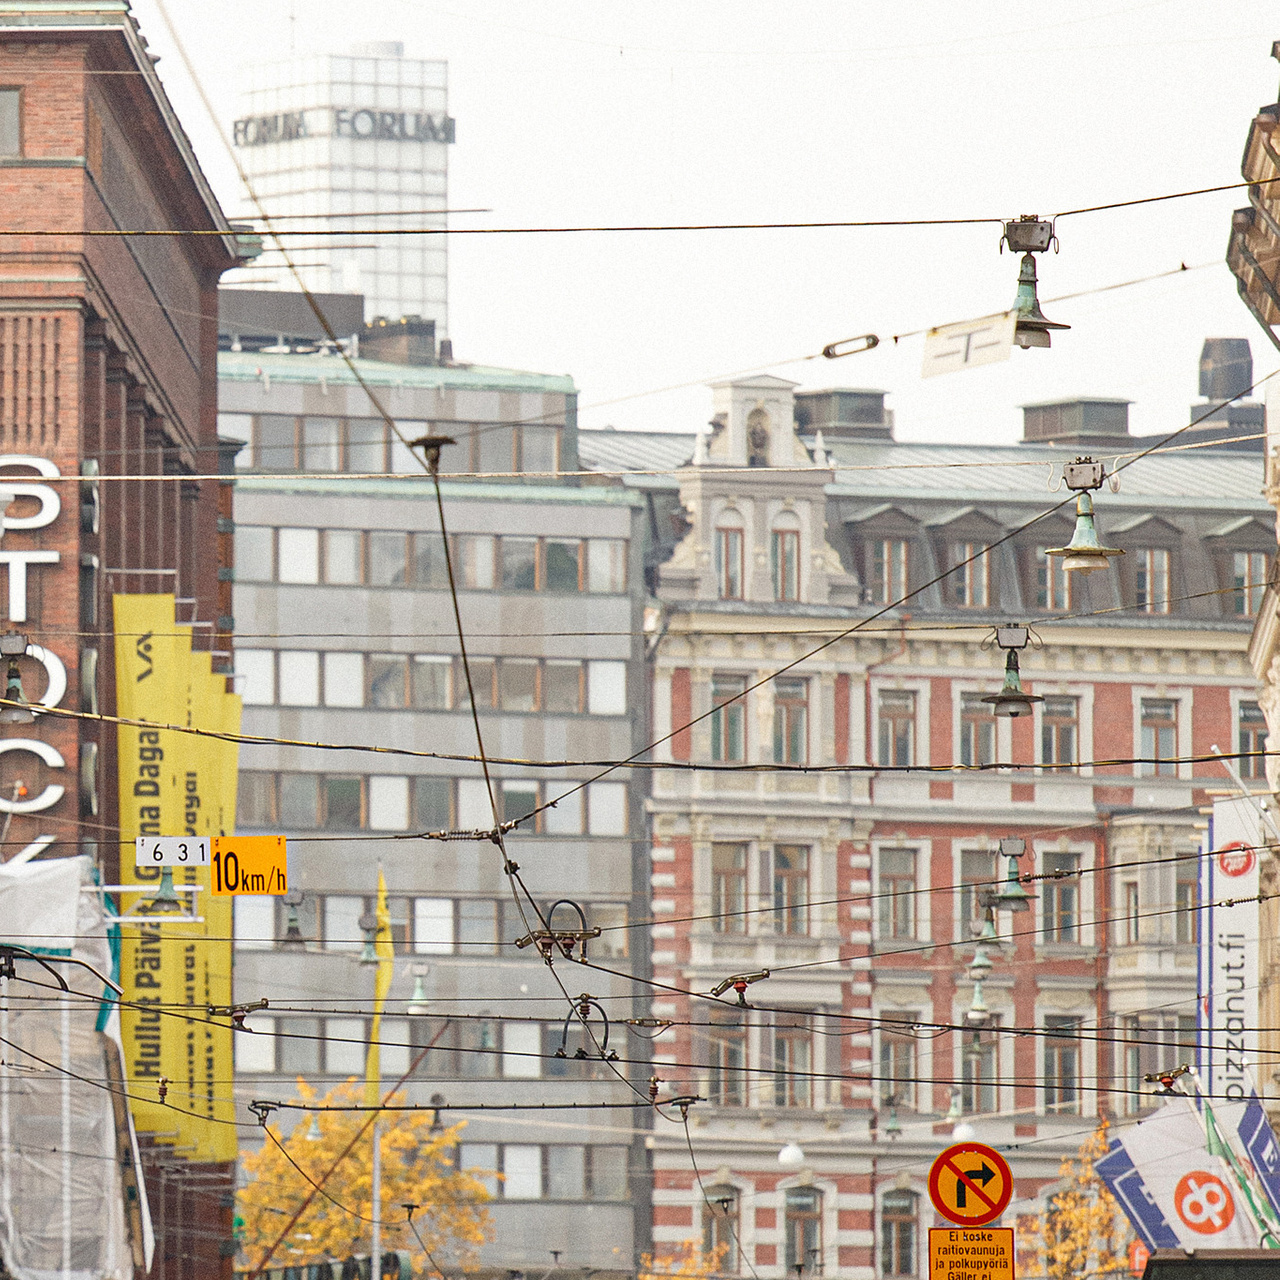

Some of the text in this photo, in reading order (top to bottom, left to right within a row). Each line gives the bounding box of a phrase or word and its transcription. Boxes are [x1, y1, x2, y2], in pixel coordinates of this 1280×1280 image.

[334, 108, 456, 144] FORUM
[1217, 933, 1250, 1104] pizzahut.fi
[133, 995, 162, 1078] Hullut
[949, 1231, 993, 1242] Ei koske
[937, 1244, 1005, 1257] raitiovaunuja
[935, 1258, 1009, 1270] ja polkupyöriä
